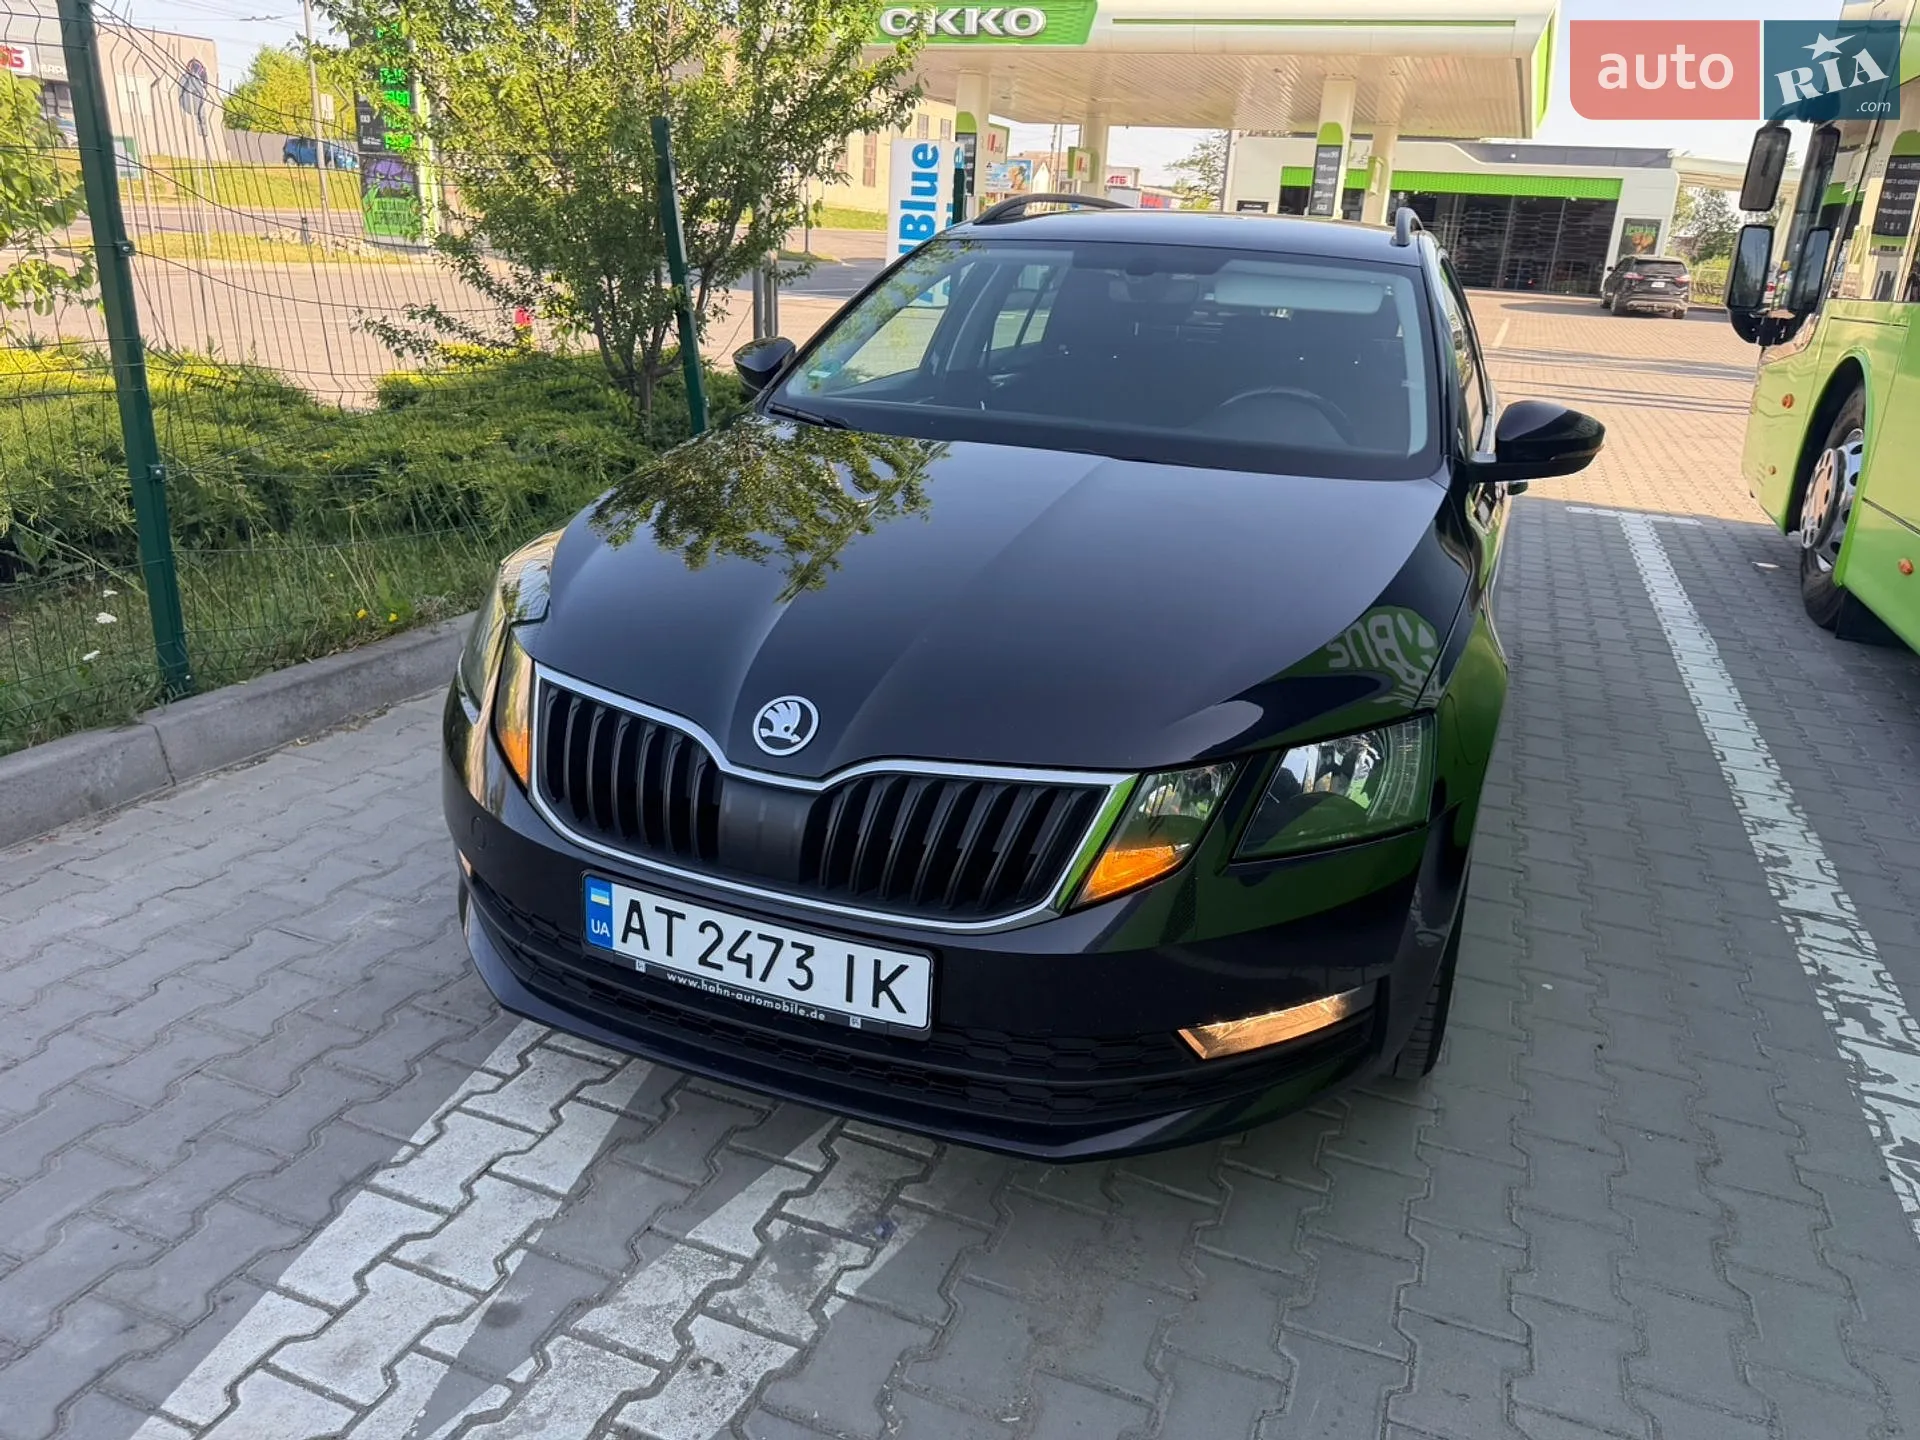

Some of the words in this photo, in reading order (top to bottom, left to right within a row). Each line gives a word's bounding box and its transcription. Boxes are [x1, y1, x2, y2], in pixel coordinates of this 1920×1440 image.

[879, 7, 1047, 37] OKKO
[590, 918, 611, 938] UA
[621, 899, 687, 957] AT
[698, 920, 815, 992] 2473
[845, 953, 909, 1014] IK
[666, 972, 826, 1021] www.hahn-automobile.de
